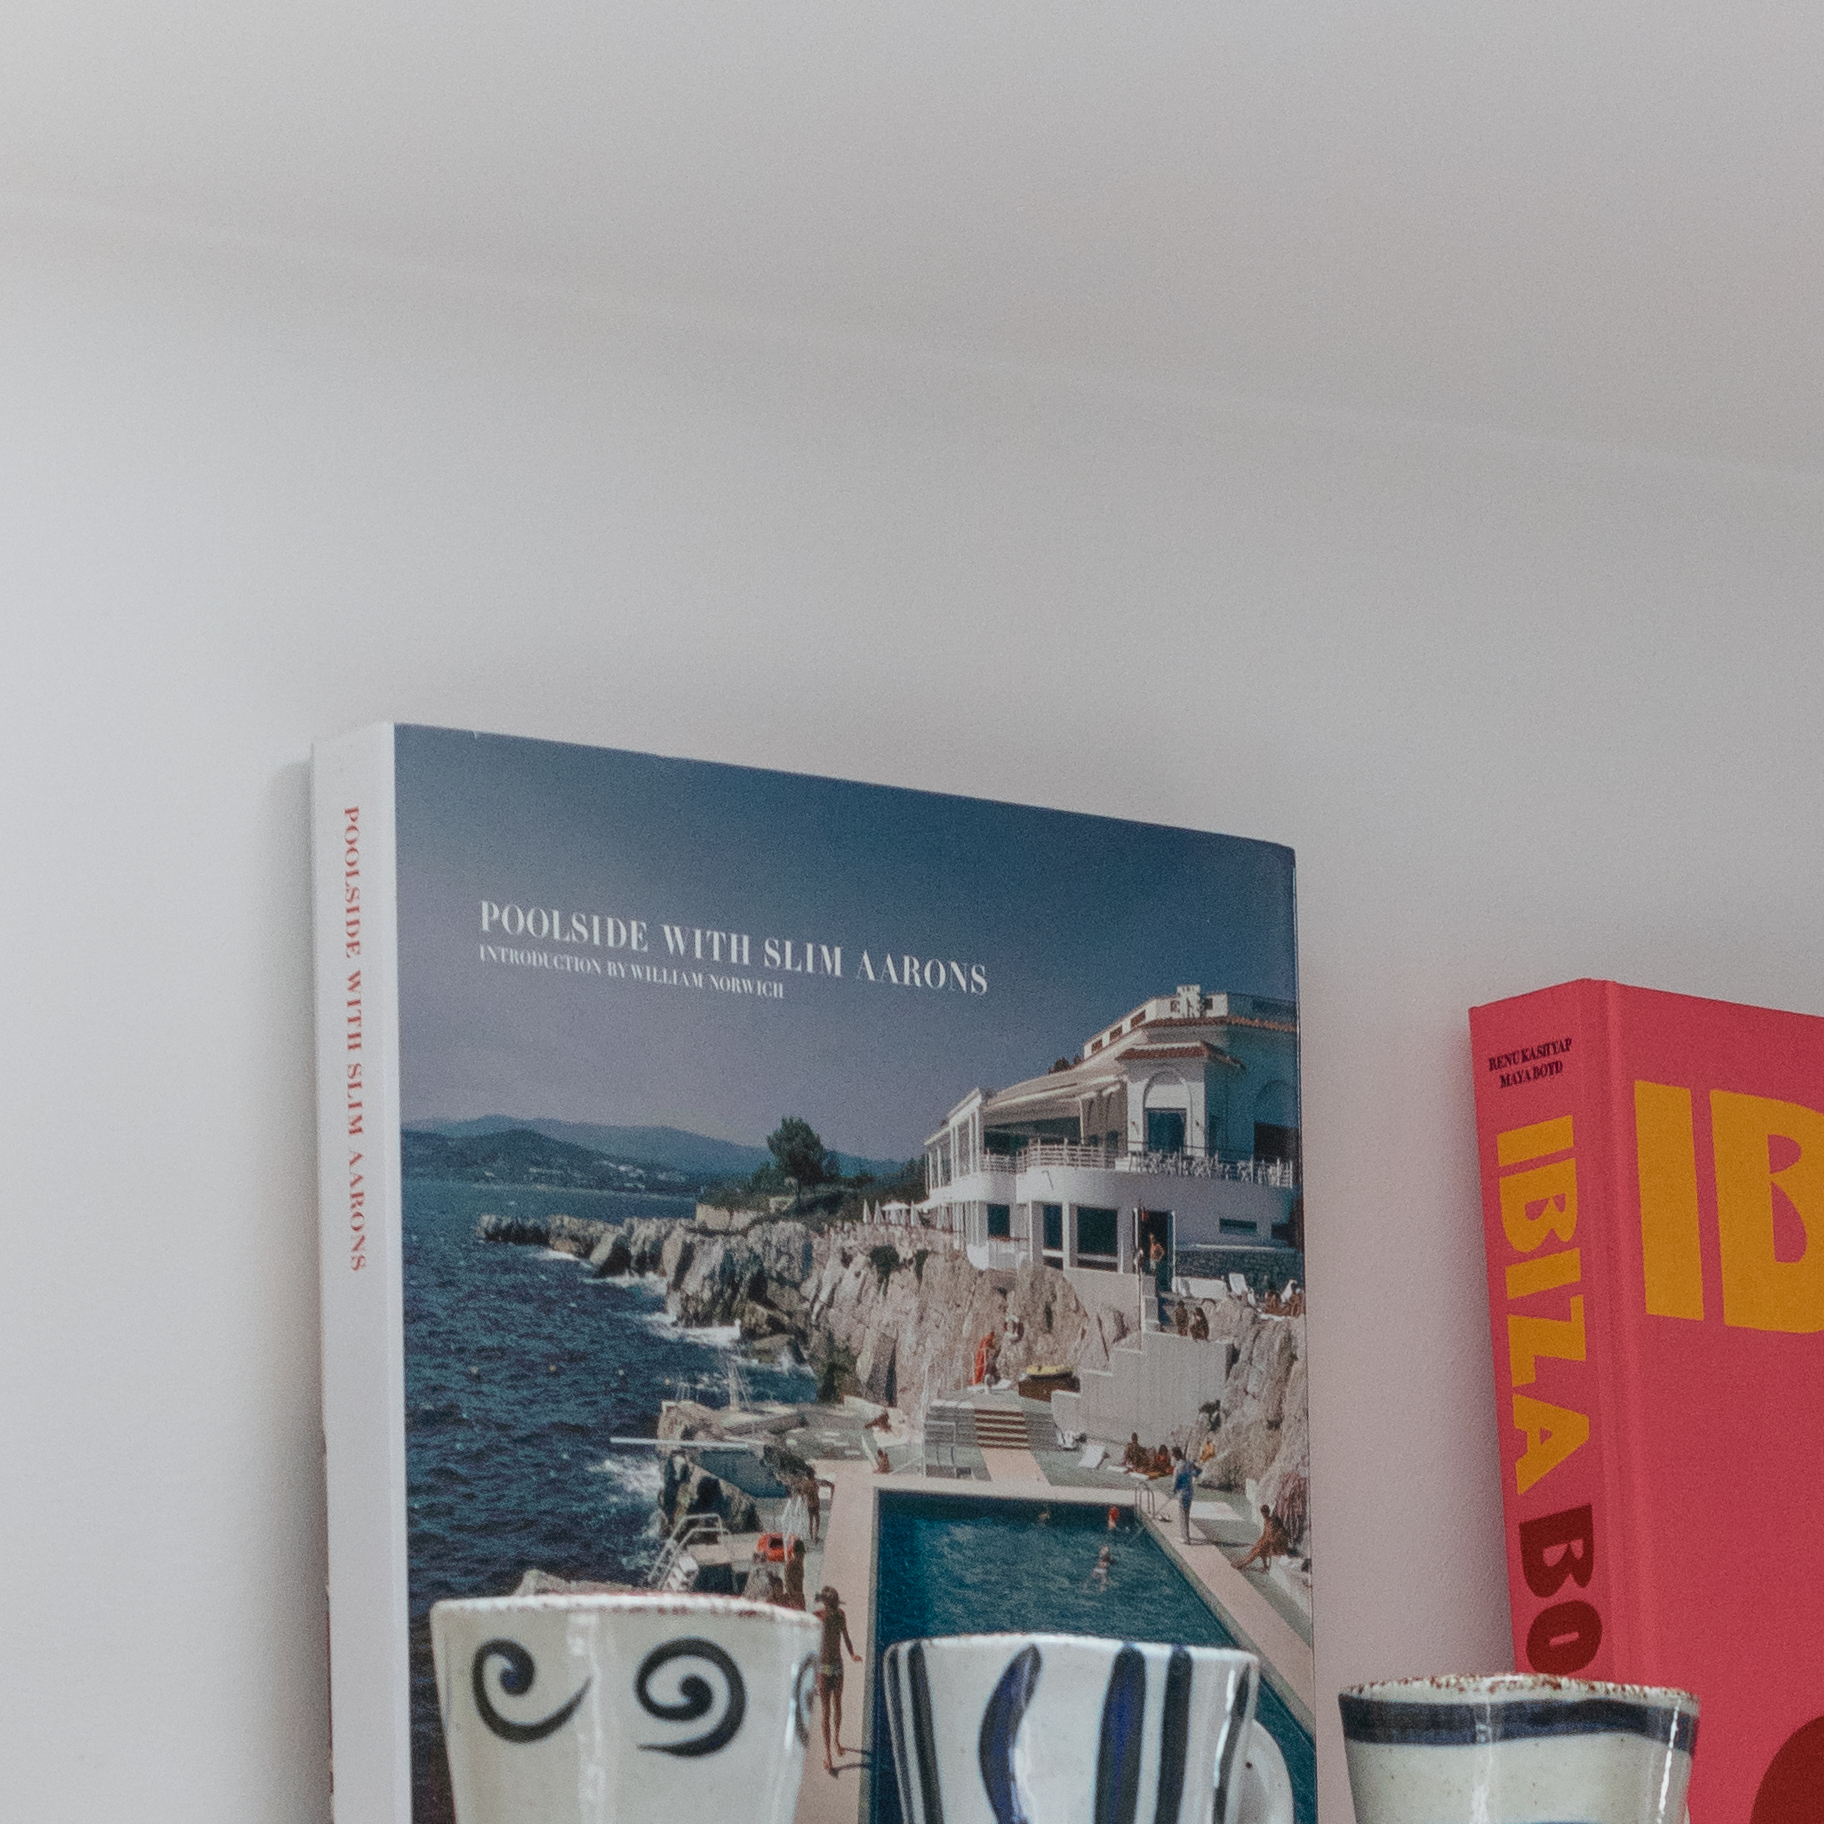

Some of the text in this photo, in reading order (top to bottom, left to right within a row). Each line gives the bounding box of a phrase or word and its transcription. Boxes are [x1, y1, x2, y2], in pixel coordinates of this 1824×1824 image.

[480, 900, 989, 996] POOLSIDE WITH SLIM AARONS
[480, 944, 785, 999] INTRODUCTION BY WILLIAM NORWICH
[344, 806, 366, 1273] POOLSIDE WITH SLIM AARONS
[1488, 1037, 1572, 1072] RENU KASHYAP
[1500, 1060, 1564, 1089] MAYA BOYD
[1497, 1115, 1590, 1496] IBIZA
